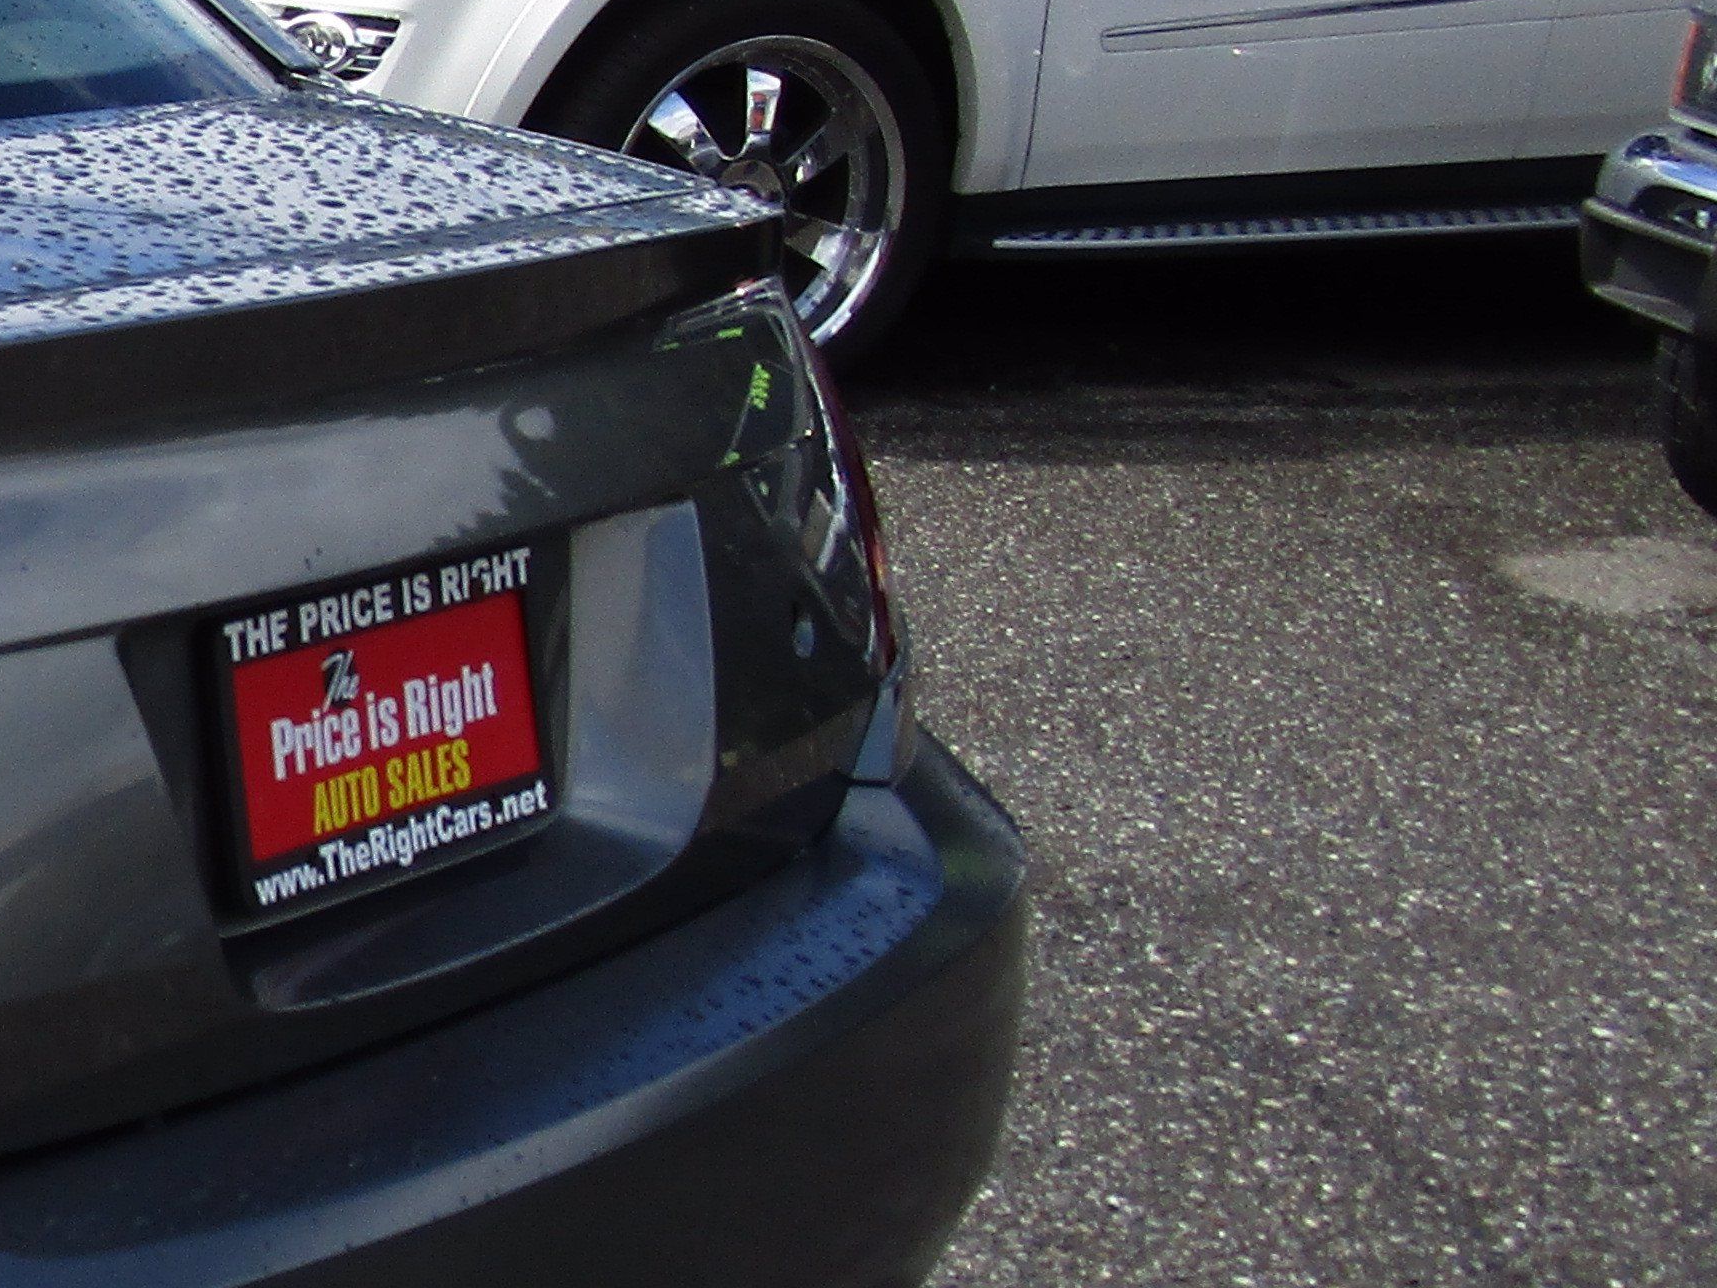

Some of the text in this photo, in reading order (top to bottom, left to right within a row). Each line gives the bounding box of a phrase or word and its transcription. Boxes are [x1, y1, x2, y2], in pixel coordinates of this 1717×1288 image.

[223, 547, 532, 662] THE PRICE IS RIGHT
[270, 661, 498, 781] Price is Right
[321, 649, 360, 714] The
[253, 779, 549, 906] www.TheRightCars.net
[314, 738, 471, 837] AUTO SALES
